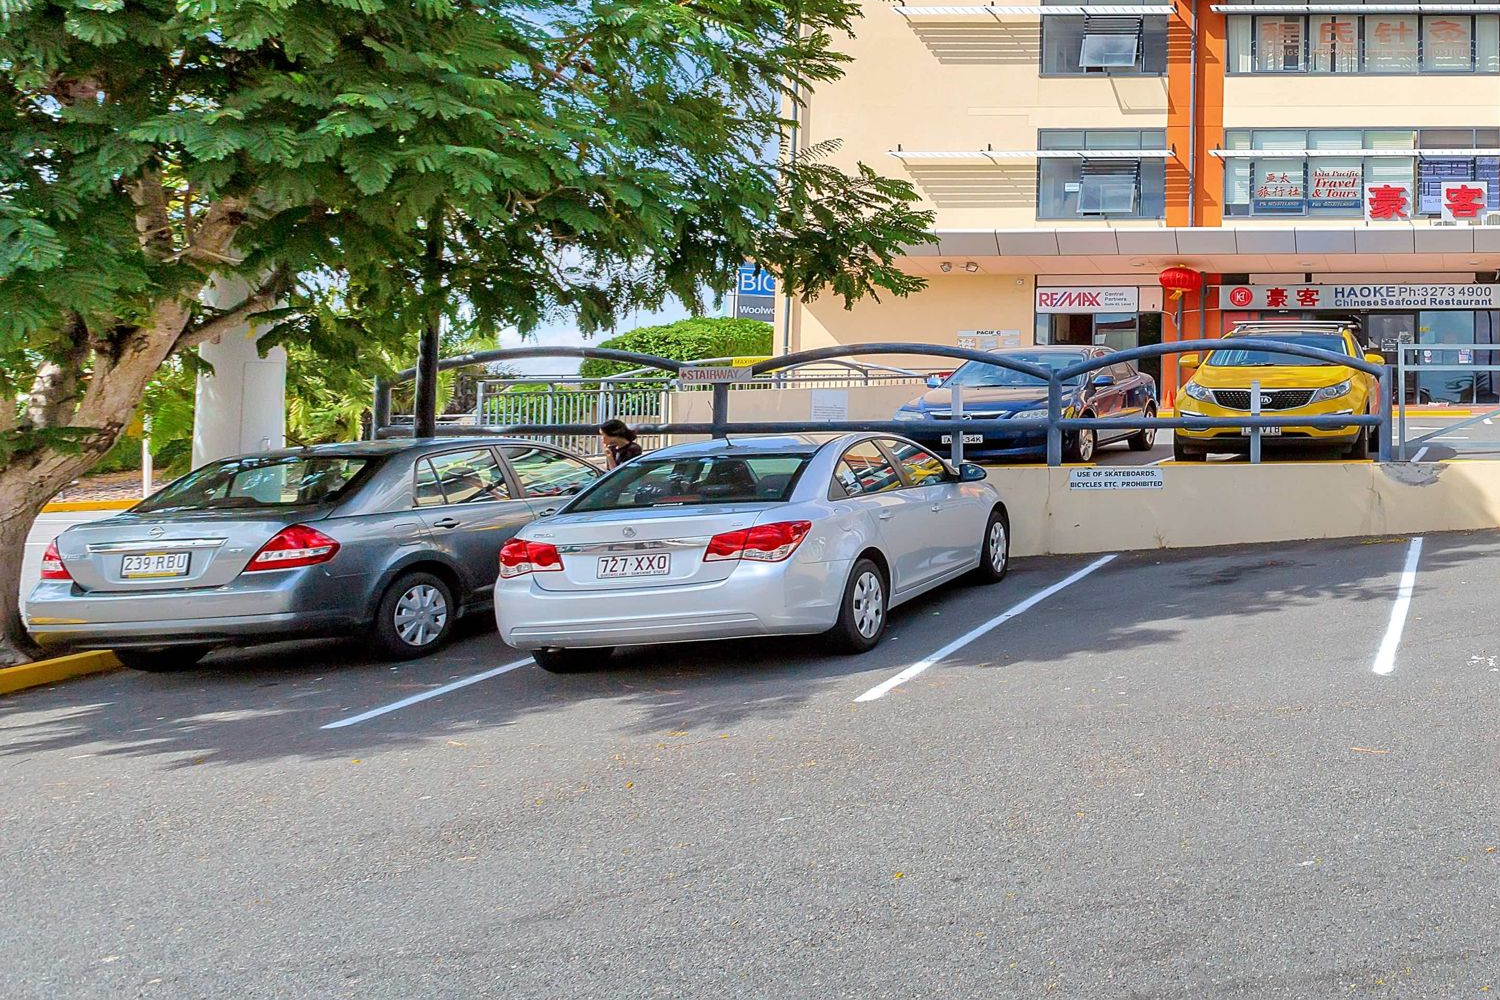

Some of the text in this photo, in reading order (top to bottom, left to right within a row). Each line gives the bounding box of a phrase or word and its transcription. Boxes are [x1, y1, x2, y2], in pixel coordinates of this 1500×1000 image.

[1313, 170, 1359, 178] Asia Pacific
[1315, 178, 1357, 188] Travel
[1257, 186, 1300, 197] 旅行社
[1312, 188, 1358, 198] & Tours
[1266, 287, 1320, 307] 豪客
[1334, 286, 1396, 298] HAOKE
[1458, 286, 1492, 297] 4900
[1038, 291, 1101, 307] RE/MAX
[1334, 298, 1493, 307] Chinese Seafood Restaurant
[687, 370, 740, 380] STAIRWAY
